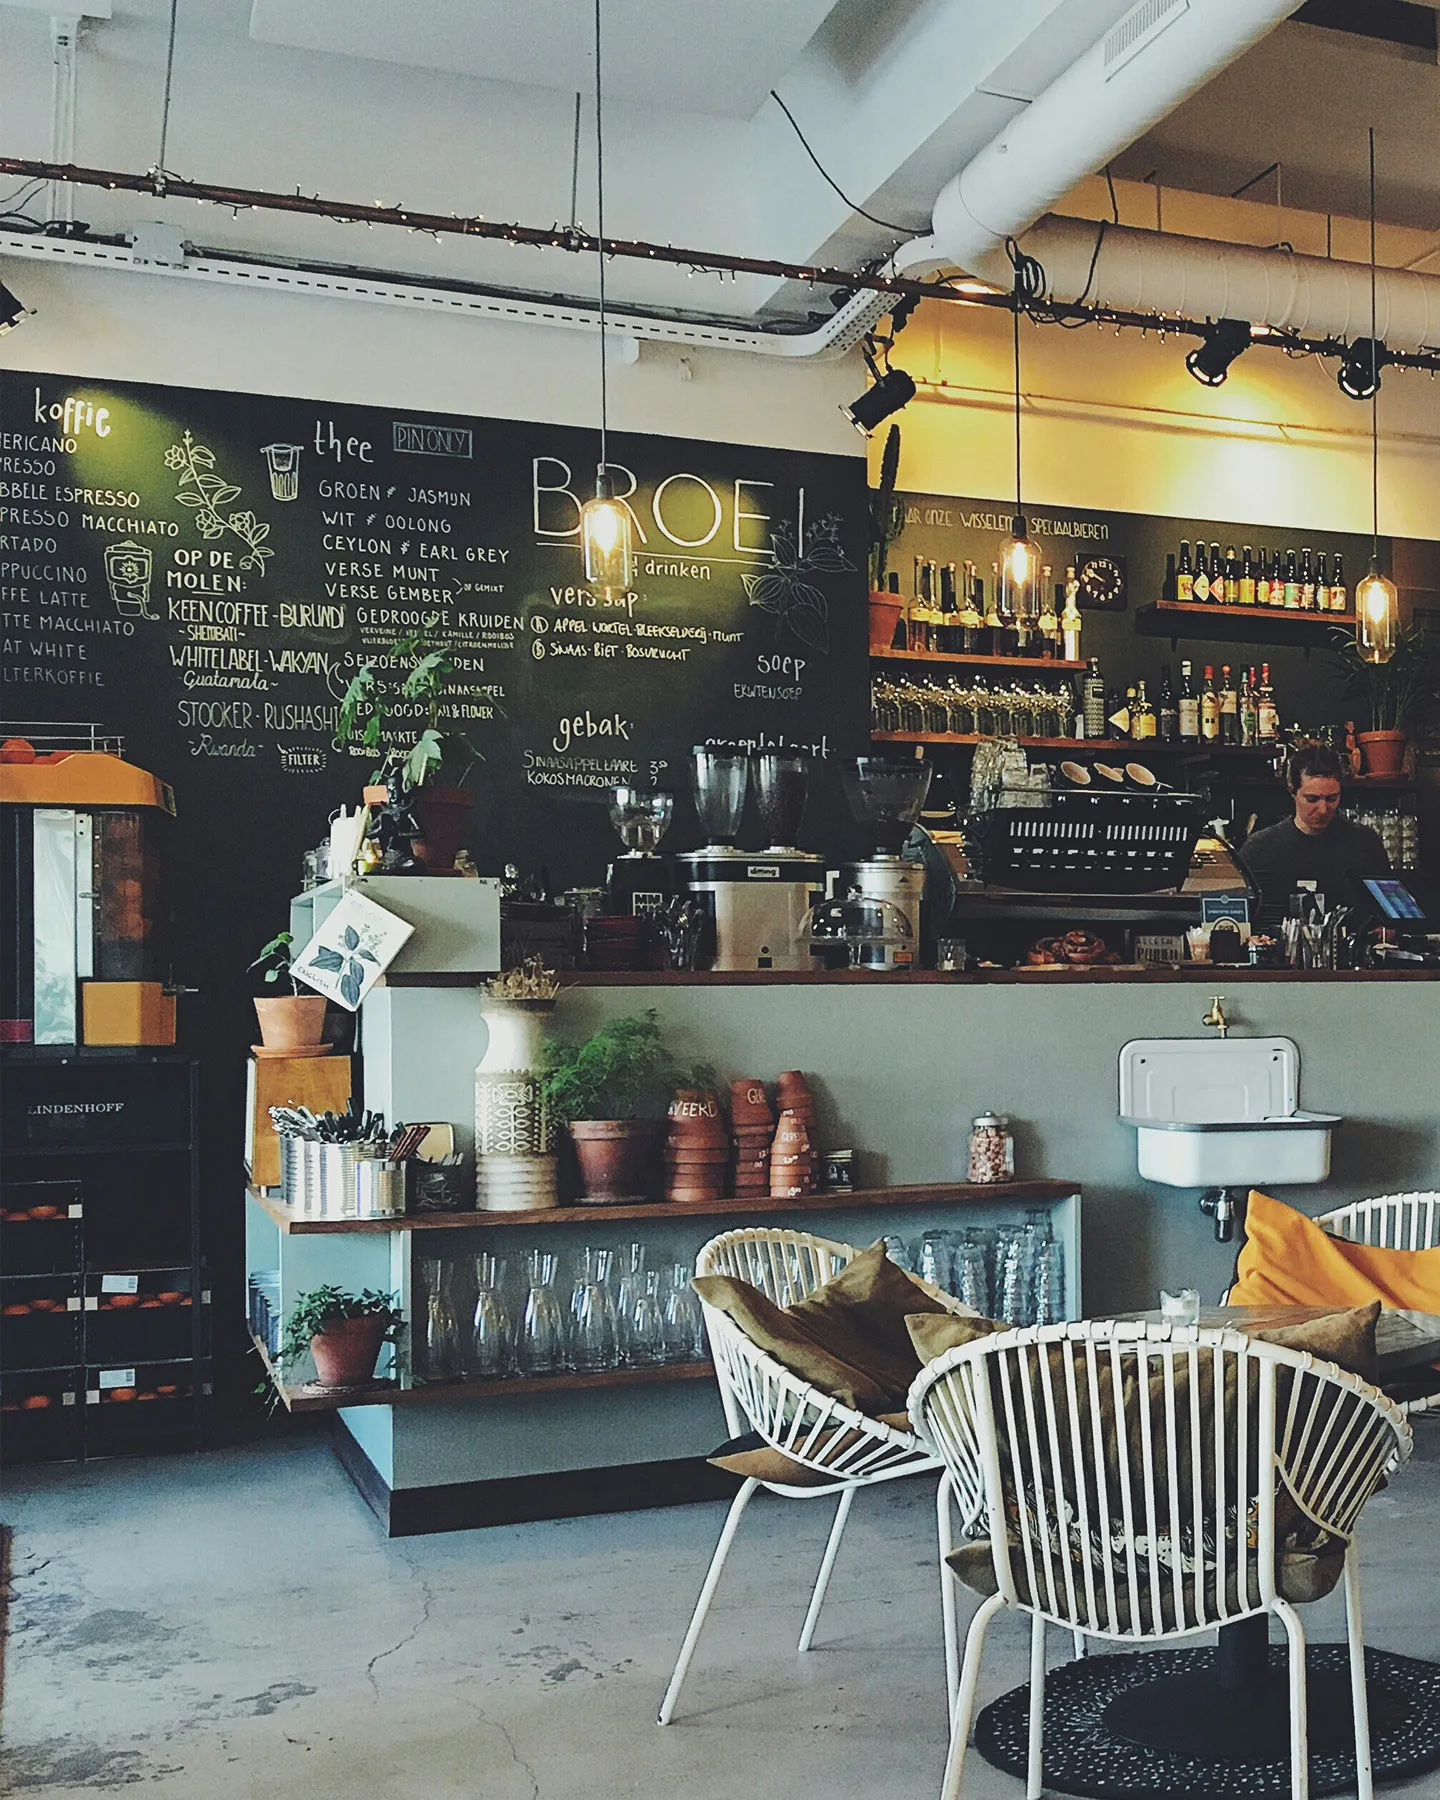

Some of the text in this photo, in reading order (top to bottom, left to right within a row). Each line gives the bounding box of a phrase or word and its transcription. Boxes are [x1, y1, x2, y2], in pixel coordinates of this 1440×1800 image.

[34, 387, 112, 438] koffie
[313, 420, 374, 463] thee
[55, 486, 140, 508] ESPRESSO
[318, 479, 471, 507] GROEN JASMIJN
[82, 513, 179, 537] MACCHIATO
[321, 510, 452, 534] WIT OOLONG
[924, 509, 954, 527] ONZE
[959, 512, 1013, 532] WISSELEN
[1029, 517, 1109, 541] SPECIAALBIEREN
[0, 535, 57, 554] RTADO
[322, 533, 510, 564] CEYLON EARL GREY
[173, 549, 235, 570] OP DE
[645, 558, 712, 581] drinken
[1, 562, 87, 583] PPUCCINO
[167, 570, 247, 594] MOLEN:
[324, 562, 440, 583] VERSE MUNT
[1, 586, 90, 608] FFE LATTE
[324, 582, 379, 599] VERSE
[387, 585, 454, 605] GEMBER
[1, 612, 136, 636] TTE MACCHIATO
[279, 602, 345, 630] BURUNDI
[356, 606, 525, 631] GEDROOGDE KRUIDEN
[553, 617, 588, 633] APPEL
[592, 621, 633, 637] WORTEL
[29, 641, 87, 660] WHITE
[169, 644, 264, 673] WHITELABEL
[3, 666, 105, 687] LTERKOFFIE
[757, 654, 806, 682] soep
[177, 700, 253, 729] STOOKER
[189, 733, 257, 758] Rwanda
[288, 756, 321, 766] FILTER
[296, 966, 330, 990] ENGLISH
[28, 1102, 125, 1115] LINDENHOFF
